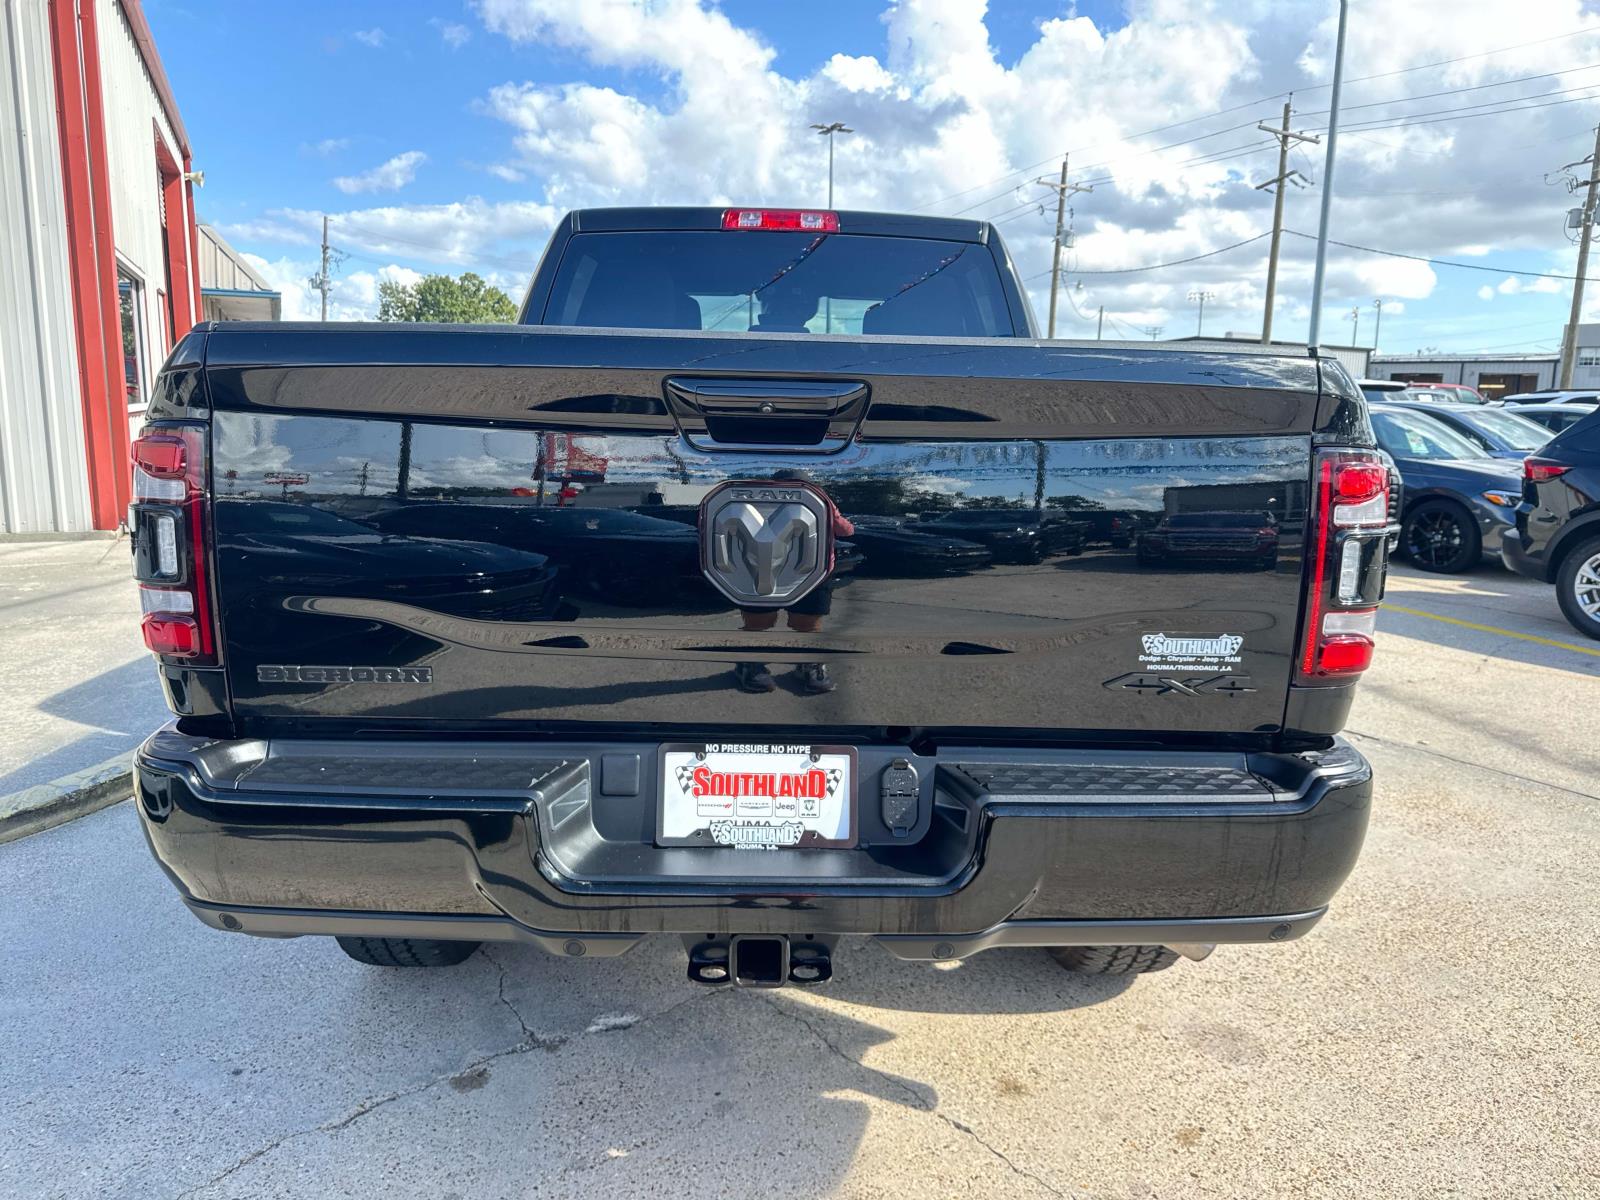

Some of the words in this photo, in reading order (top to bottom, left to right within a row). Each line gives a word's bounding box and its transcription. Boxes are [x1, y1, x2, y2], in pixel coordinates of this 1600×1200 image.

[731, 490, 801, 499] RAM
[1153, 635, 1232, 655] SOUTHLAND
[256, 665, 433, 683] BIGHORN
[705, 744, 719, 752] NO
[721, 744, 769, 753] PRESSURE
[771, 745, 784, 753] NO
[787, 745, 810, 753] HYPE
[693, 767, 827, 799] SOUTHLAND
[775, 802, 795, 811] Jeep
[720, 825, 795, 844] SOUTHLAND
